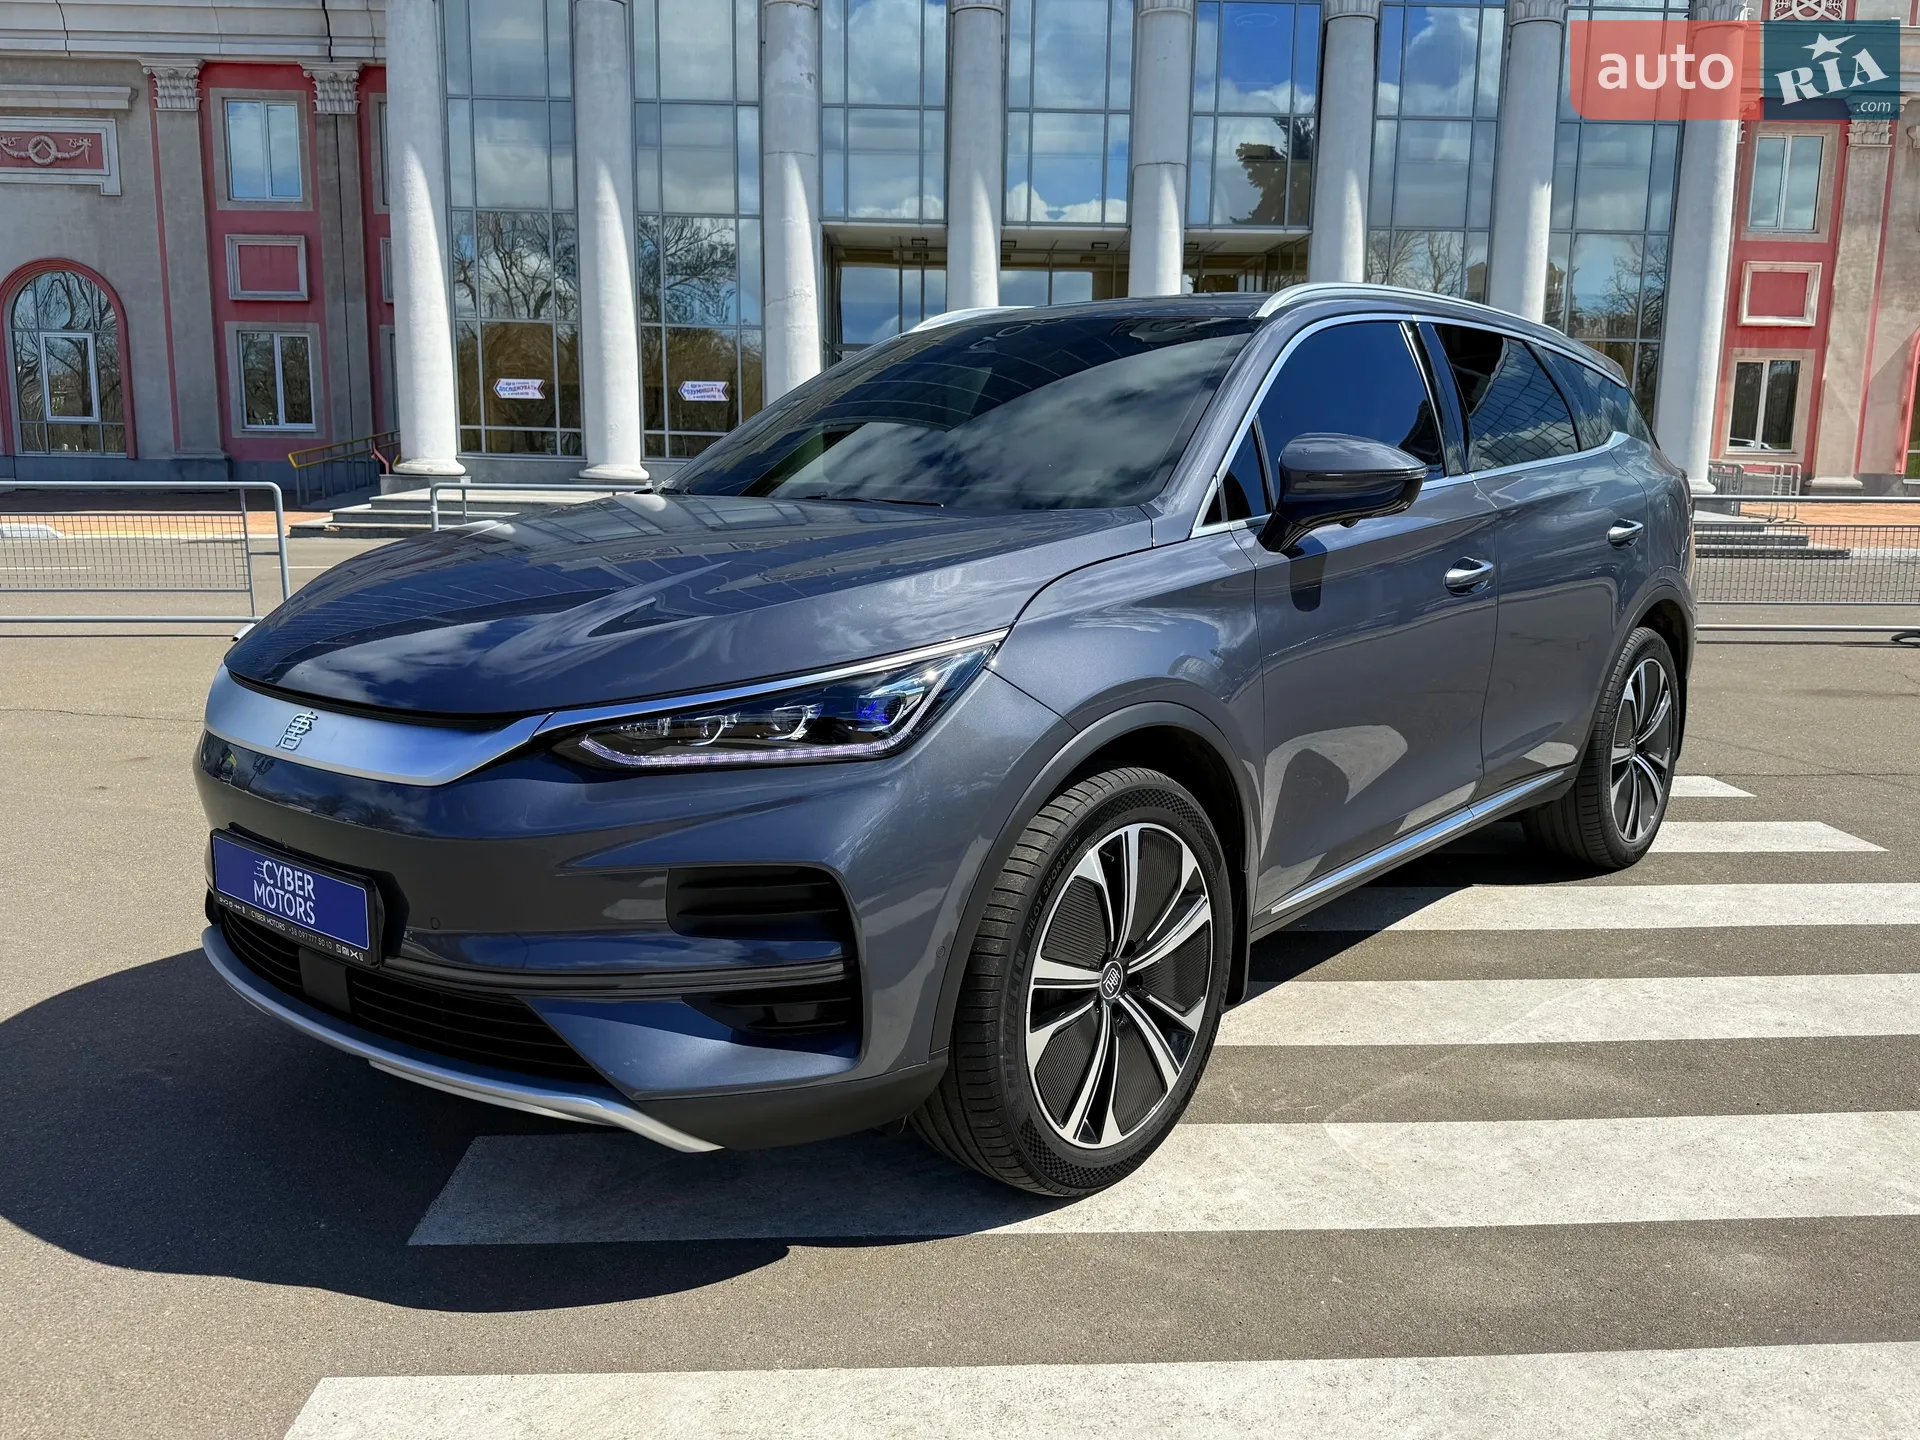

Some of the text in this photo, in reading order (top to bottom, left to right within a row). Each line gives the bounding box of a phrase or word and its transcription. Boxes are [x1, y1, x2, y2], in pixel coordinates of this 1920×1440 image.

[253, 879, 316, 925] MOTORS
[263, 860, 316, 900] CYBER
[1026, 897, 1043, 938] PILOT
[1043, 855, 1067, 895] SPORT
[251, 910, 266, 922] CYBER
[266, 917, 286, 931] MOTORS
[1005, 947, 1027, 1090] MICHELIN
